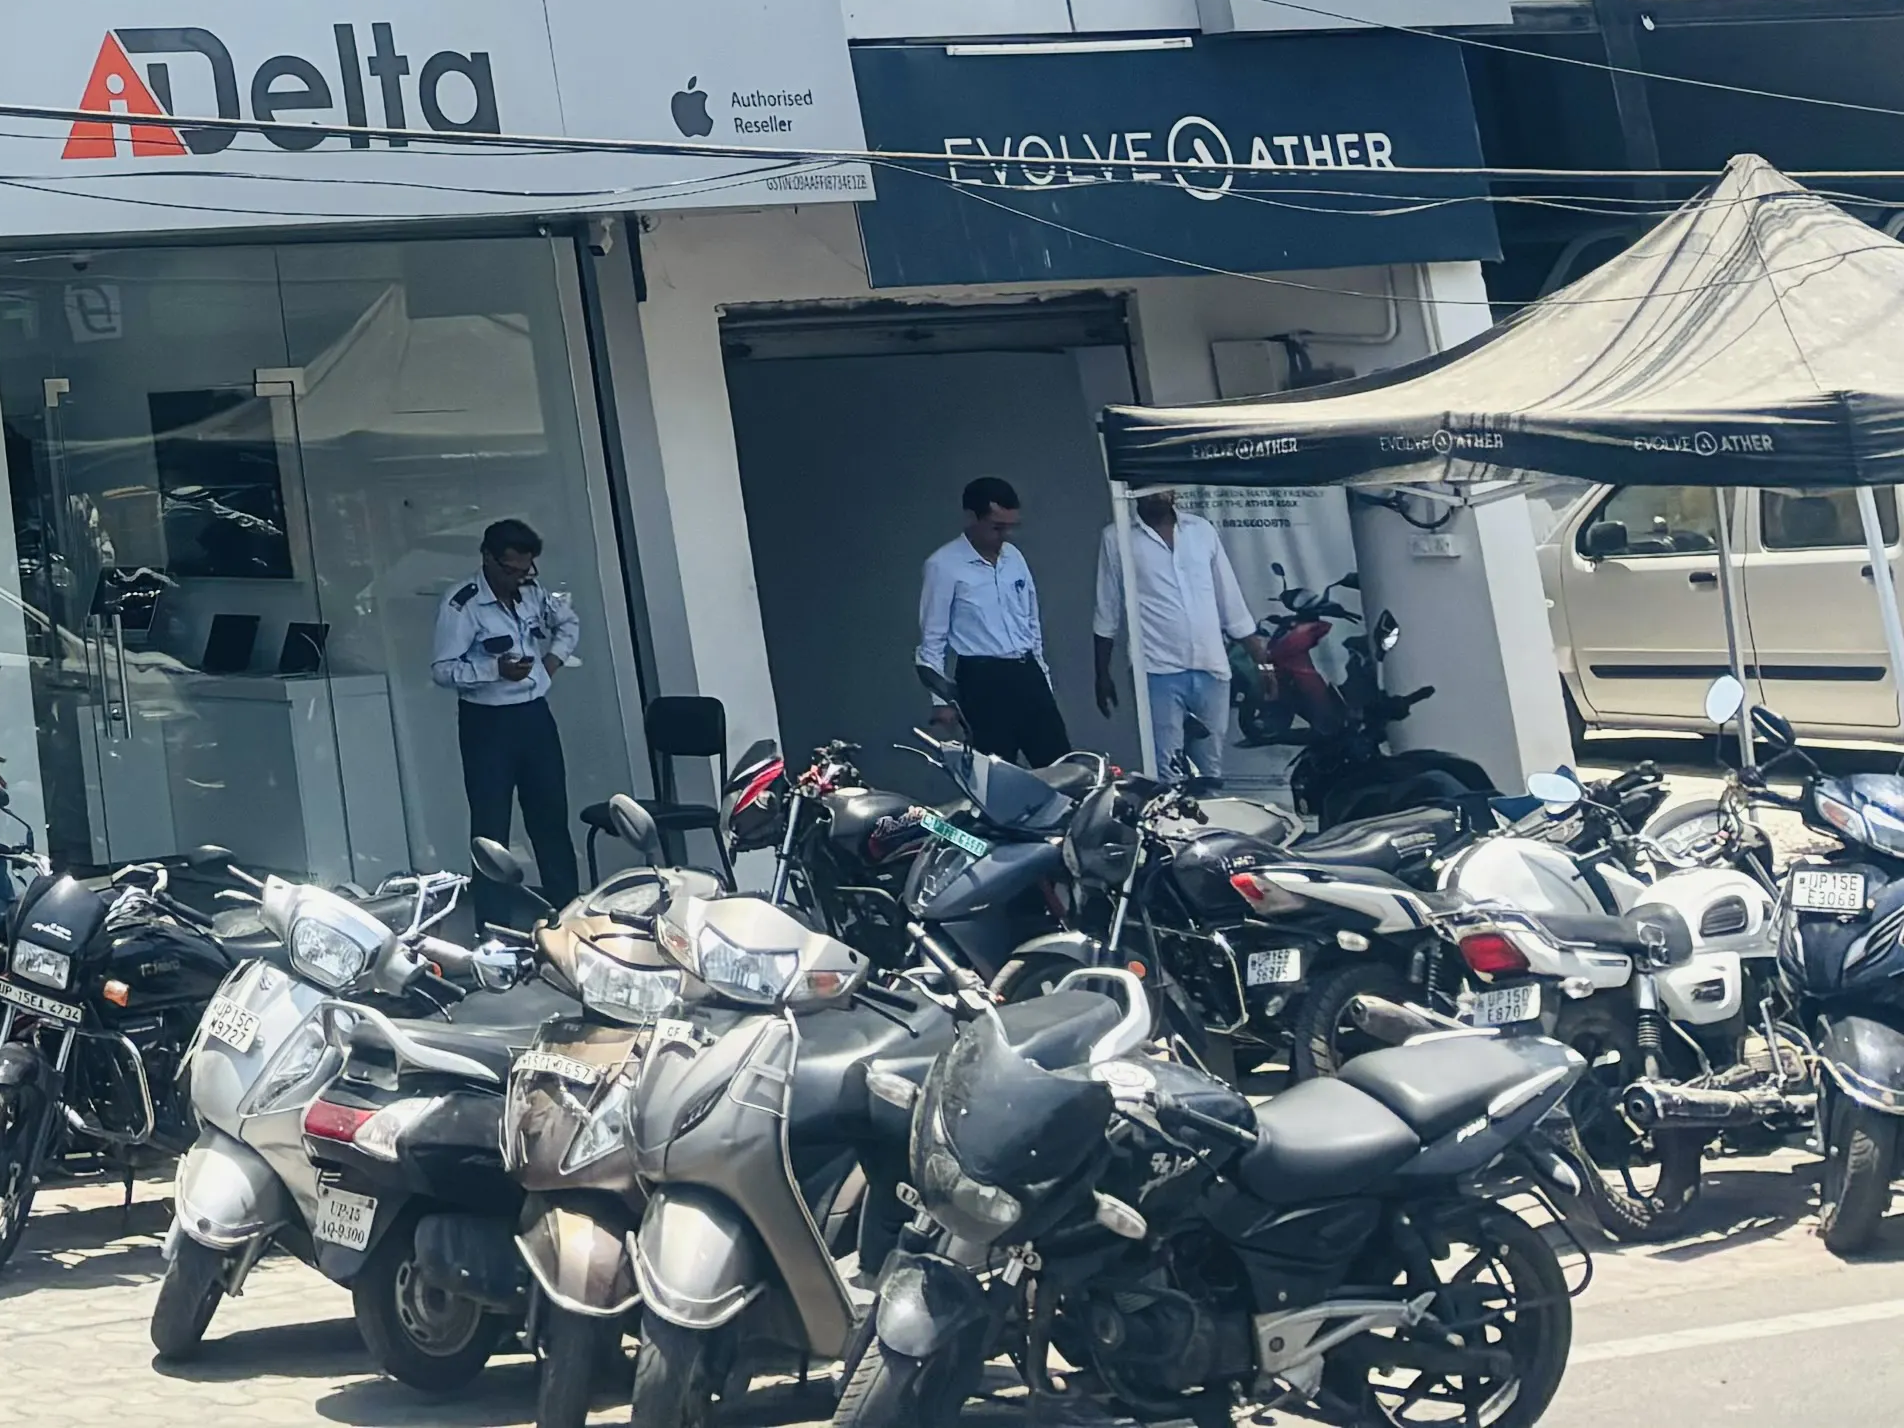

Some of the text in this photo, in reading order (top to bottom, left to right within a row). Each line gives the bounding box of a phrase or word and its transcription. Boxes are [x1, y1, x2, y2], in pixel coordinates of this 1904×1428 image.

[730, 87, 813, 110] Authorised
[733, 114, 794, 135] Reseller
[944, 132, 1394, 189] EVOLVE ATHER
[1253, 437, 1299, 457] ATHER
[1457, 433, 1504, 449] ATHER
[1634, 434, 1773, 452] EVOLVE ATHER
